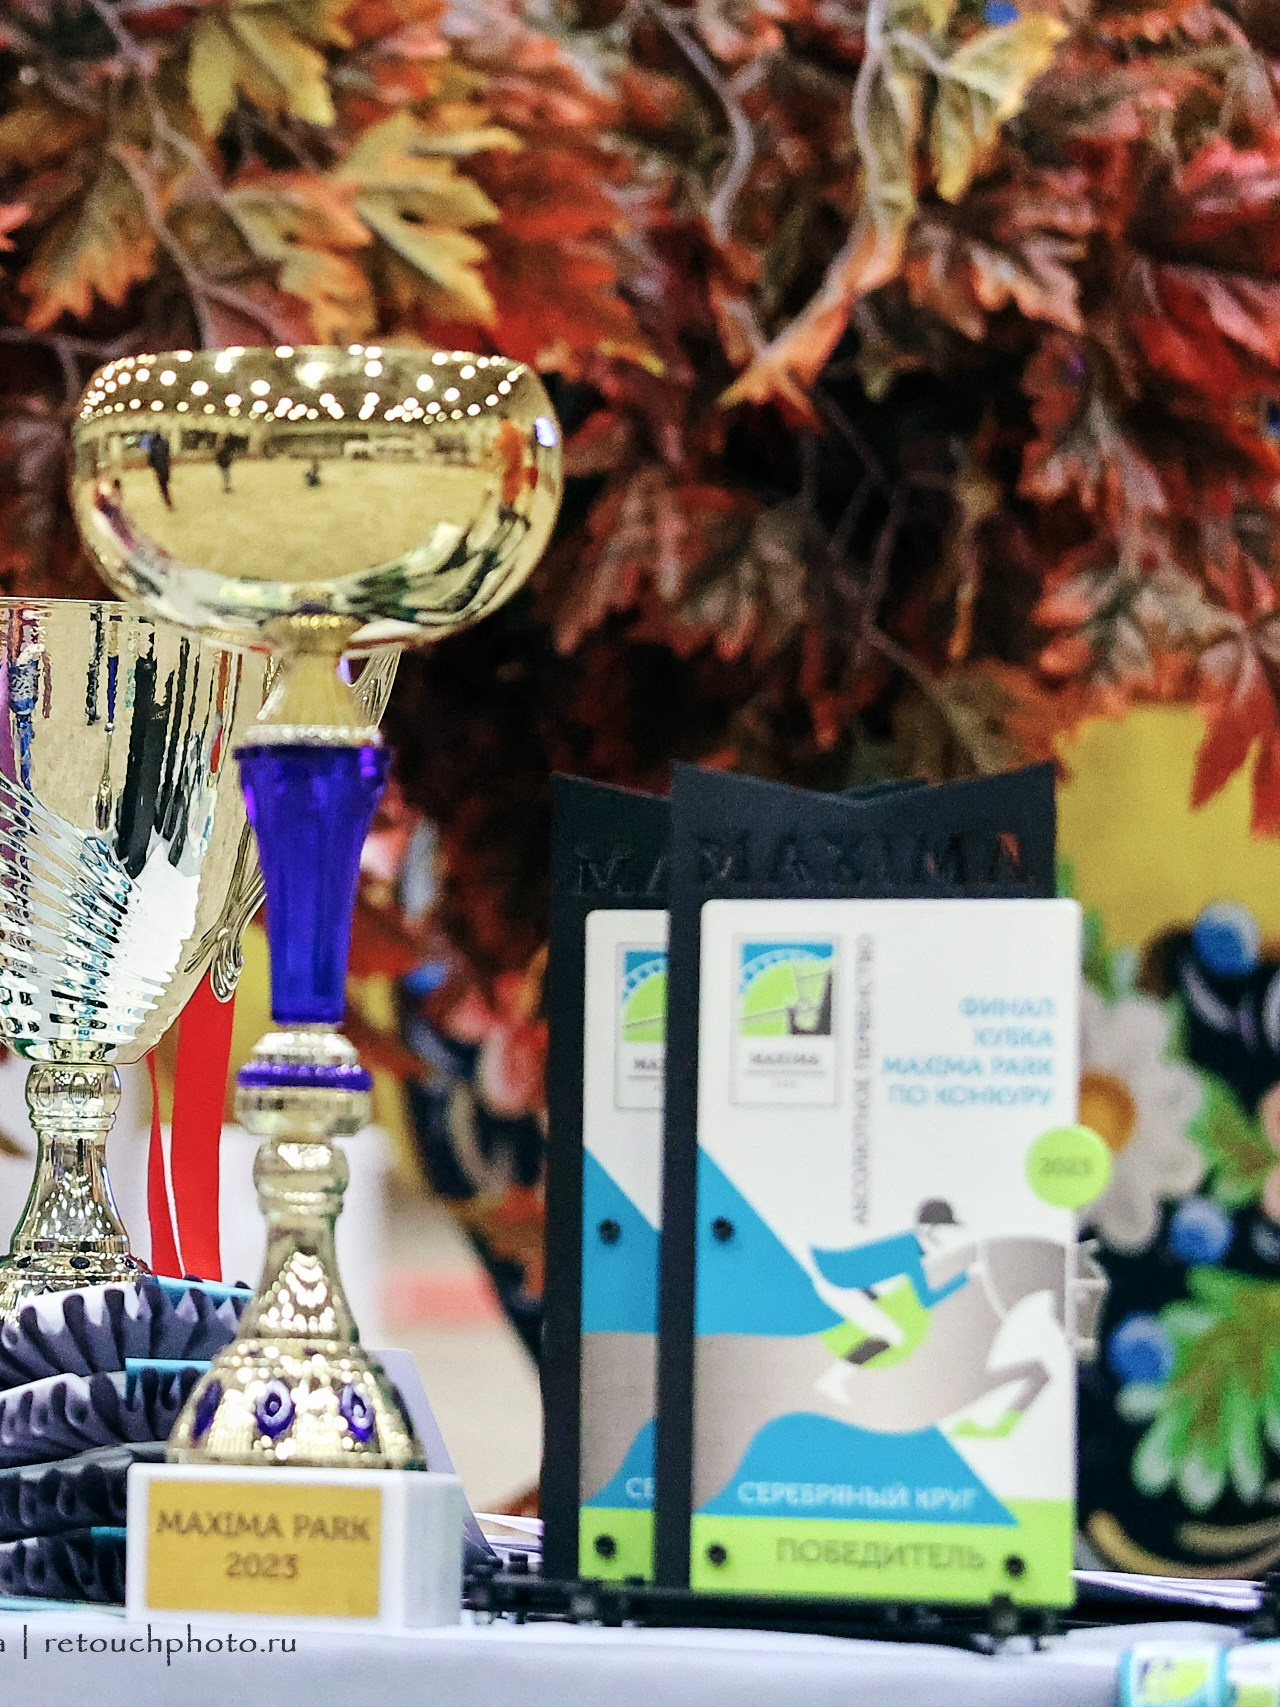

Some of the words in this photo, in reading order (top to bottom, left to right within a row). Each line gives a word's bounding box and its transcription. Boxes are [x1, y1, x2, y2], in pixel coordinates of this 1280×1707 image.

[883, 1055, 982, 1076] MAXIMA
[991, 1056, 1053, 1076] PARK
[888, 1084, 928, 1106] ПО
[935, 1085, 1054, 1106] КОНКУРУ
[737, 1480, 910, 1508] СЕРЕБРЯНЫЙ
[915, 1486, 977, 1511] КРУГ
[155, 1509, 284, 1539] MAXIMA
[292, 1513, 373, 1541] PARK
[225, 1552, 299, 1579] 2023
[776, 1537, 987, 1570] ПОБЕДИТЕЛЬ
